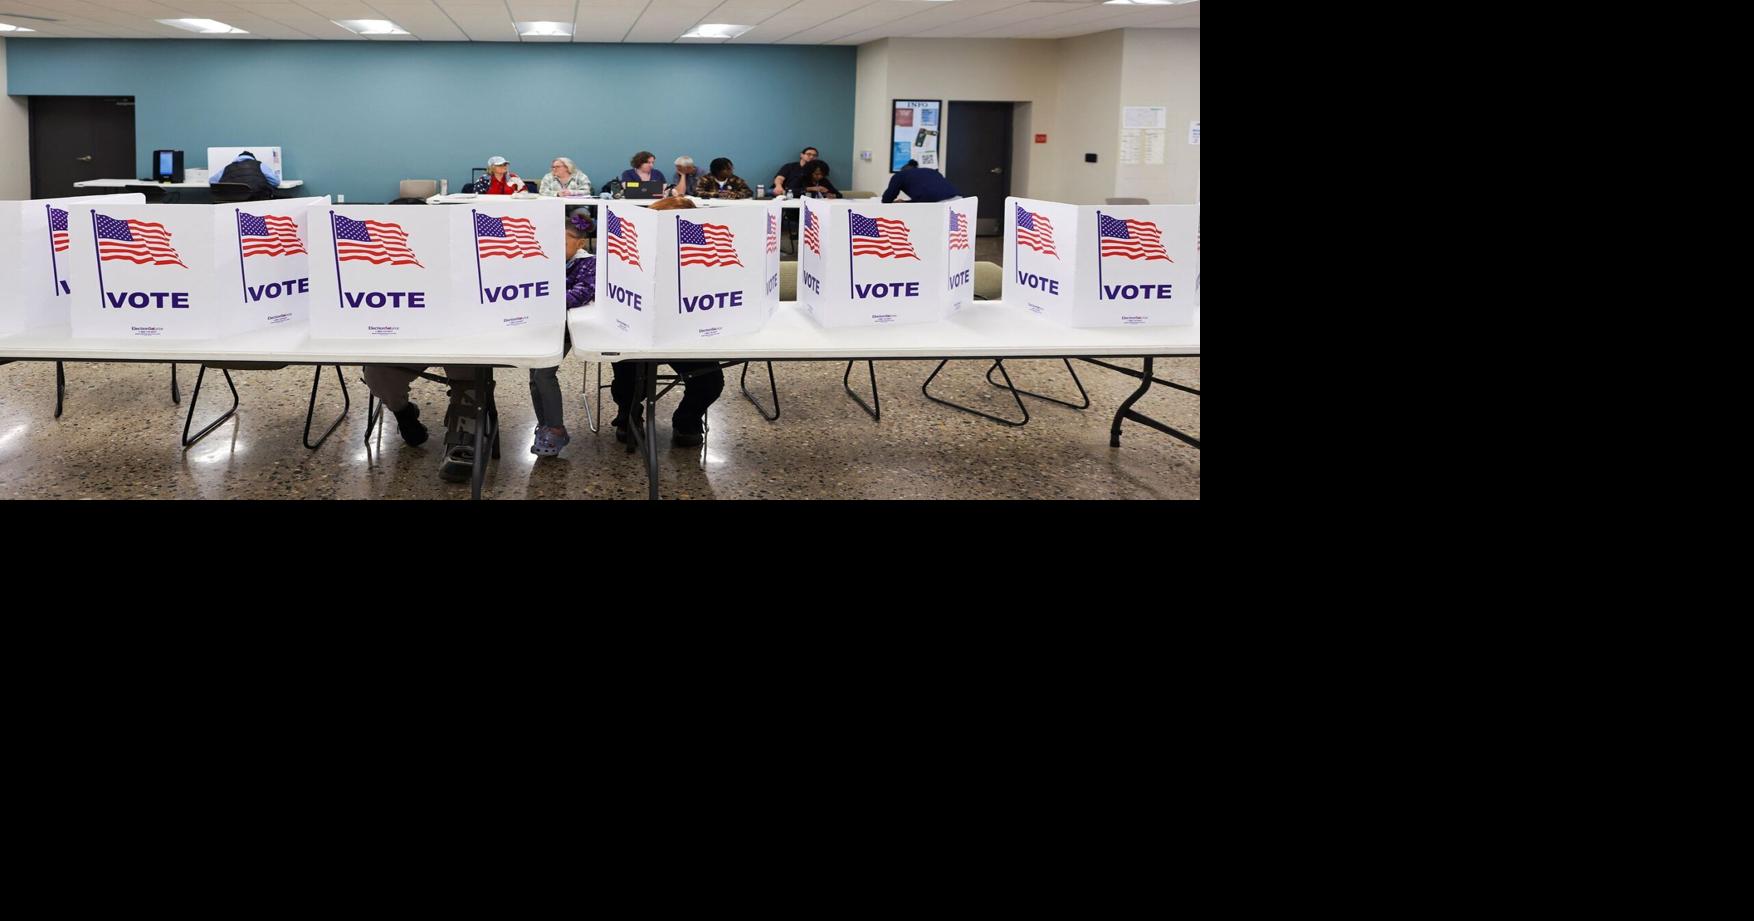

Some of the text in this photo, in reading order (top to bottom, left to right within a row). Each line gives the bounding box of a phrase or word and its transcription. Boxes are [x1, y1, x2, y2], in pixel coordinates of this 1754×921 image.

[248, 278, 308, 302] VOTE
[767, 272, 777, 295] VOTE
[803, 270, 820, 295] VOTE
[856, 282, 919, 299] VOTE
[950, 269, 970, 290] VOTE
[1018, 271, 1059, 295] VOTE
[106, 292, 189, 308] VOTE
[344, 292, 425, 308] VOTE
[484, 281, 549, 304] VOTE
[608, 282, 642, 311] VOTE
[683, 291, 743, 312] VOTE
[1104, 284, 1172, 300] VOTE
